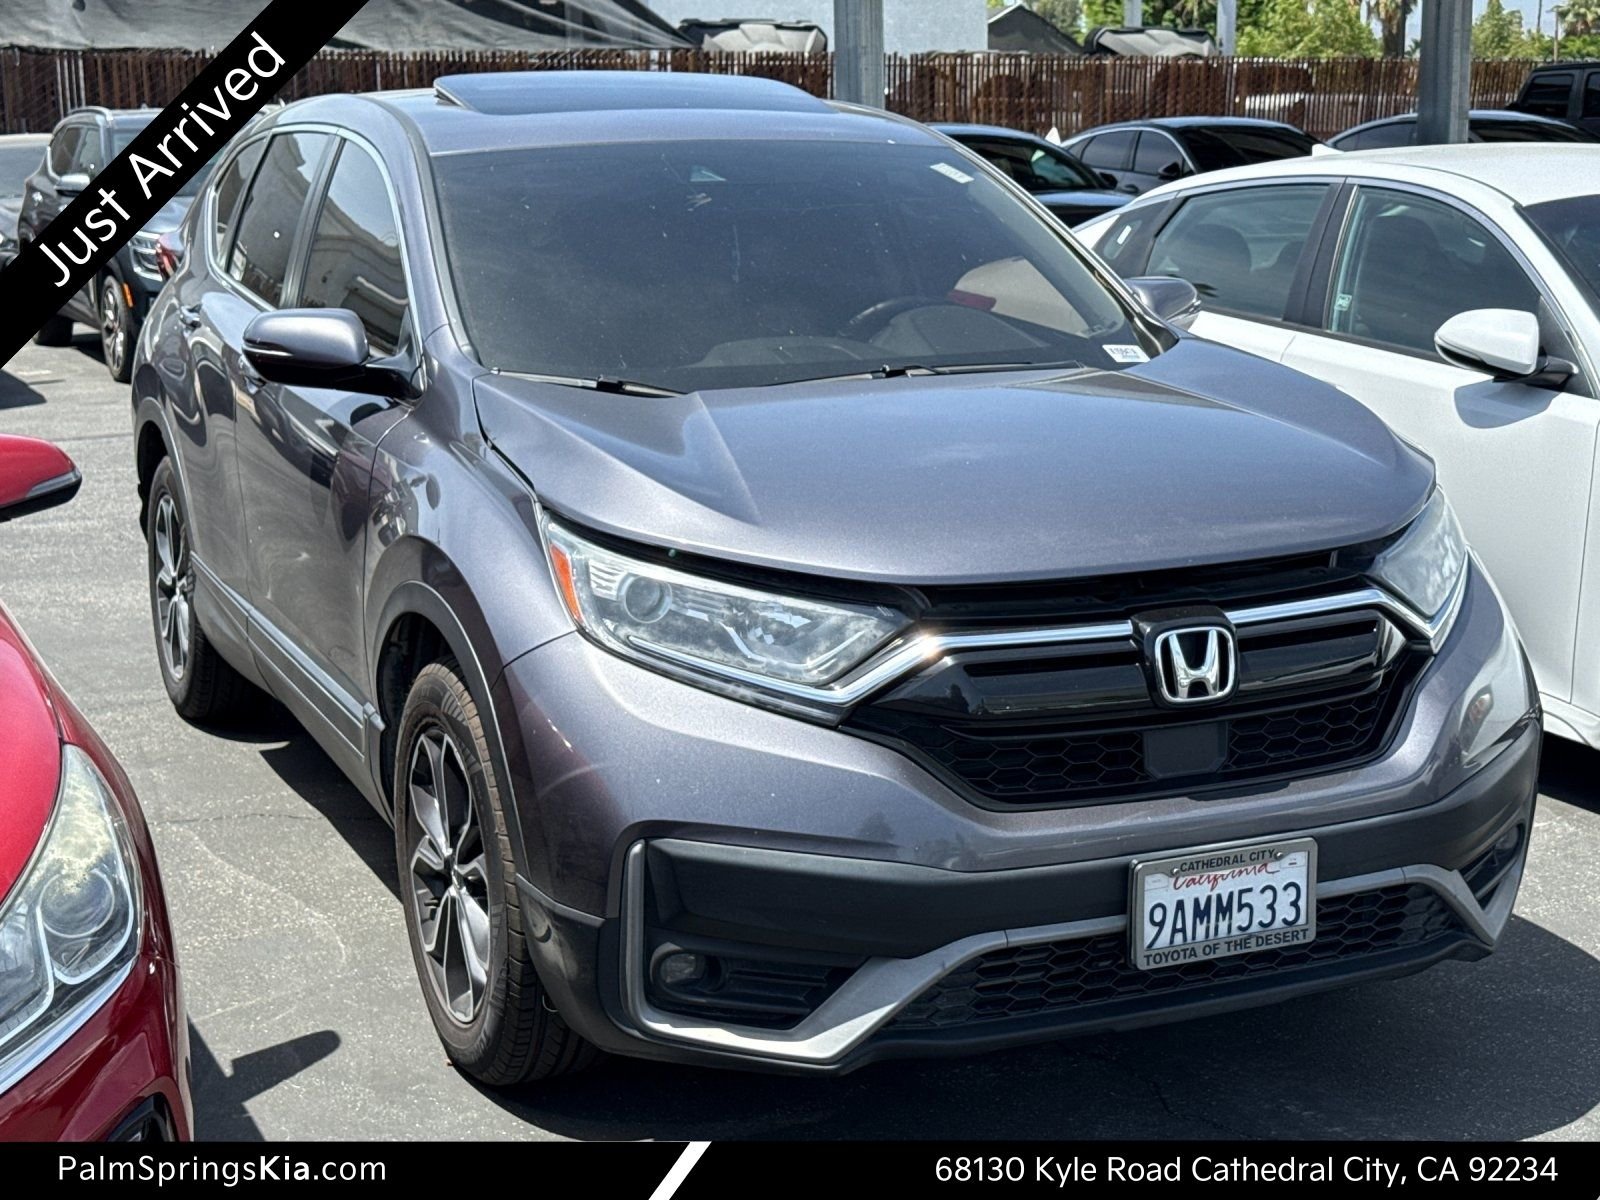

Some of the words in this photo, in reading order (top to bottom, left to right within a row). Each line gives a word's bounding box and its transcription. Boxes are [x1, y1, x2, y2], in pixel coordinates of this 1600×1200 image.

[1180, 854, 1246, 872] CATHEDRAL
[1249, 848, 1276, 861] CITY
[1146, 881, 1302, 949] 9AMM533
[1143, 947, 1198, 967] TOYOTA
[1202, 942, 1221, 957] OF
[1225, 937, 1251, 953] THE
[1255, 928, 1309, 948] DESERT
